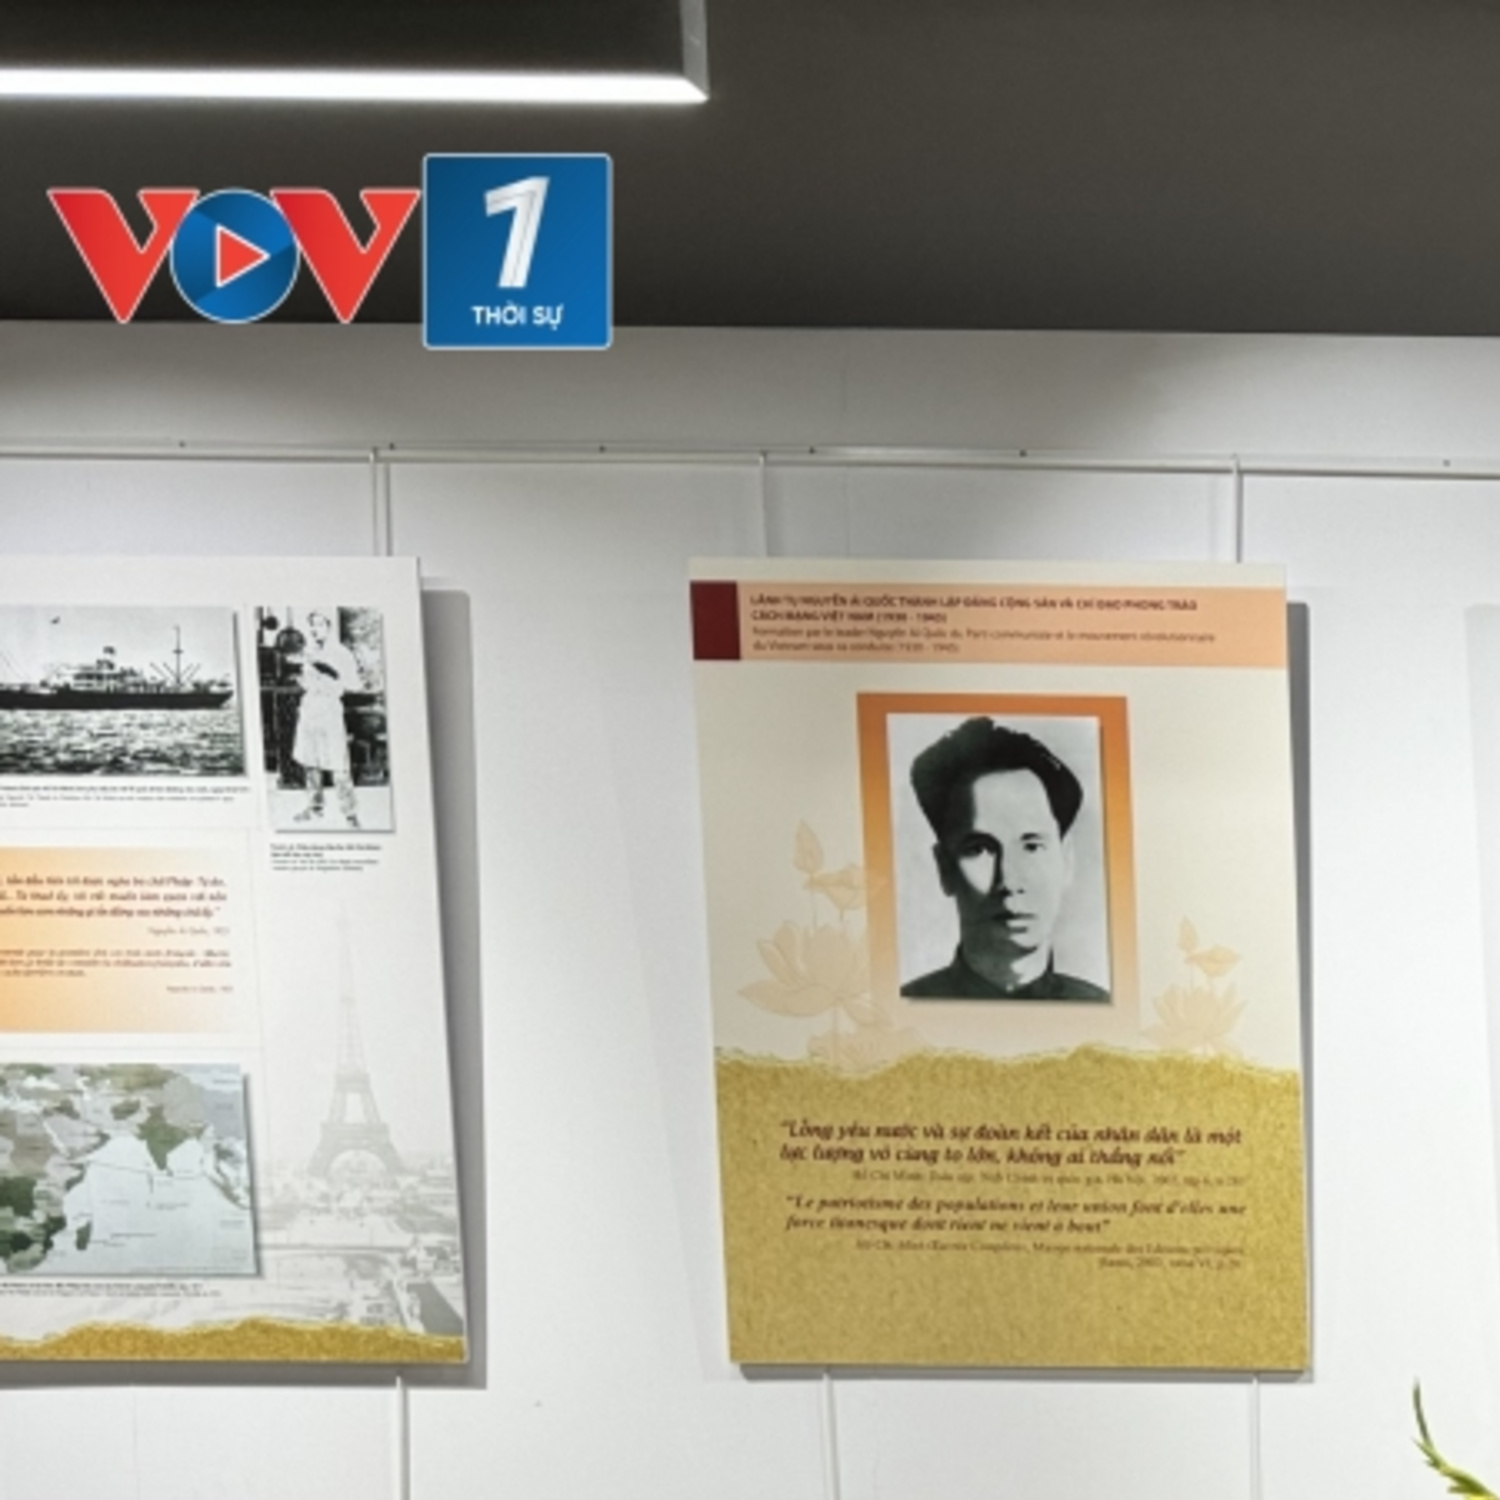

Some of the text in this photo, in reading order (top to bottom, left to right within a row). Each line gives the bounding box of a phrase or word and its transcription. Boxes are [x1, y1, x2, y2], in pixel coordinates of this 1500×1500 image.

[836, 1120, 870, 1141] yêu
[875, 1123, 917, 1138] nước
[923, 1123, 943, 1139] và
[950, 1125, 971, 1144] sự
[974, 1122, 1019, 1141] đoàn
[1024, 1123, 1051, 1141] kết
[1056, 1123, 1088, 1141] của
[1094, 1125, 1140, 1142] nhân
[1144, 1126, 1178, 1143] dân
[1184, 1126, 1200, 1143] là
[1206, 1127, 1241, 1146] một
[813, 1144, 863, 1164] lượng
[870, 1146, 890, 1161] vô
[896, 1145, 940, 1166] cùng
[944, 1146, 963, 1161] to
[1006, 1146, 1061, 1167] không
[1067, 1148, 1084, 1164] ai
[1090, 1146, 1141, 1169] thắng
